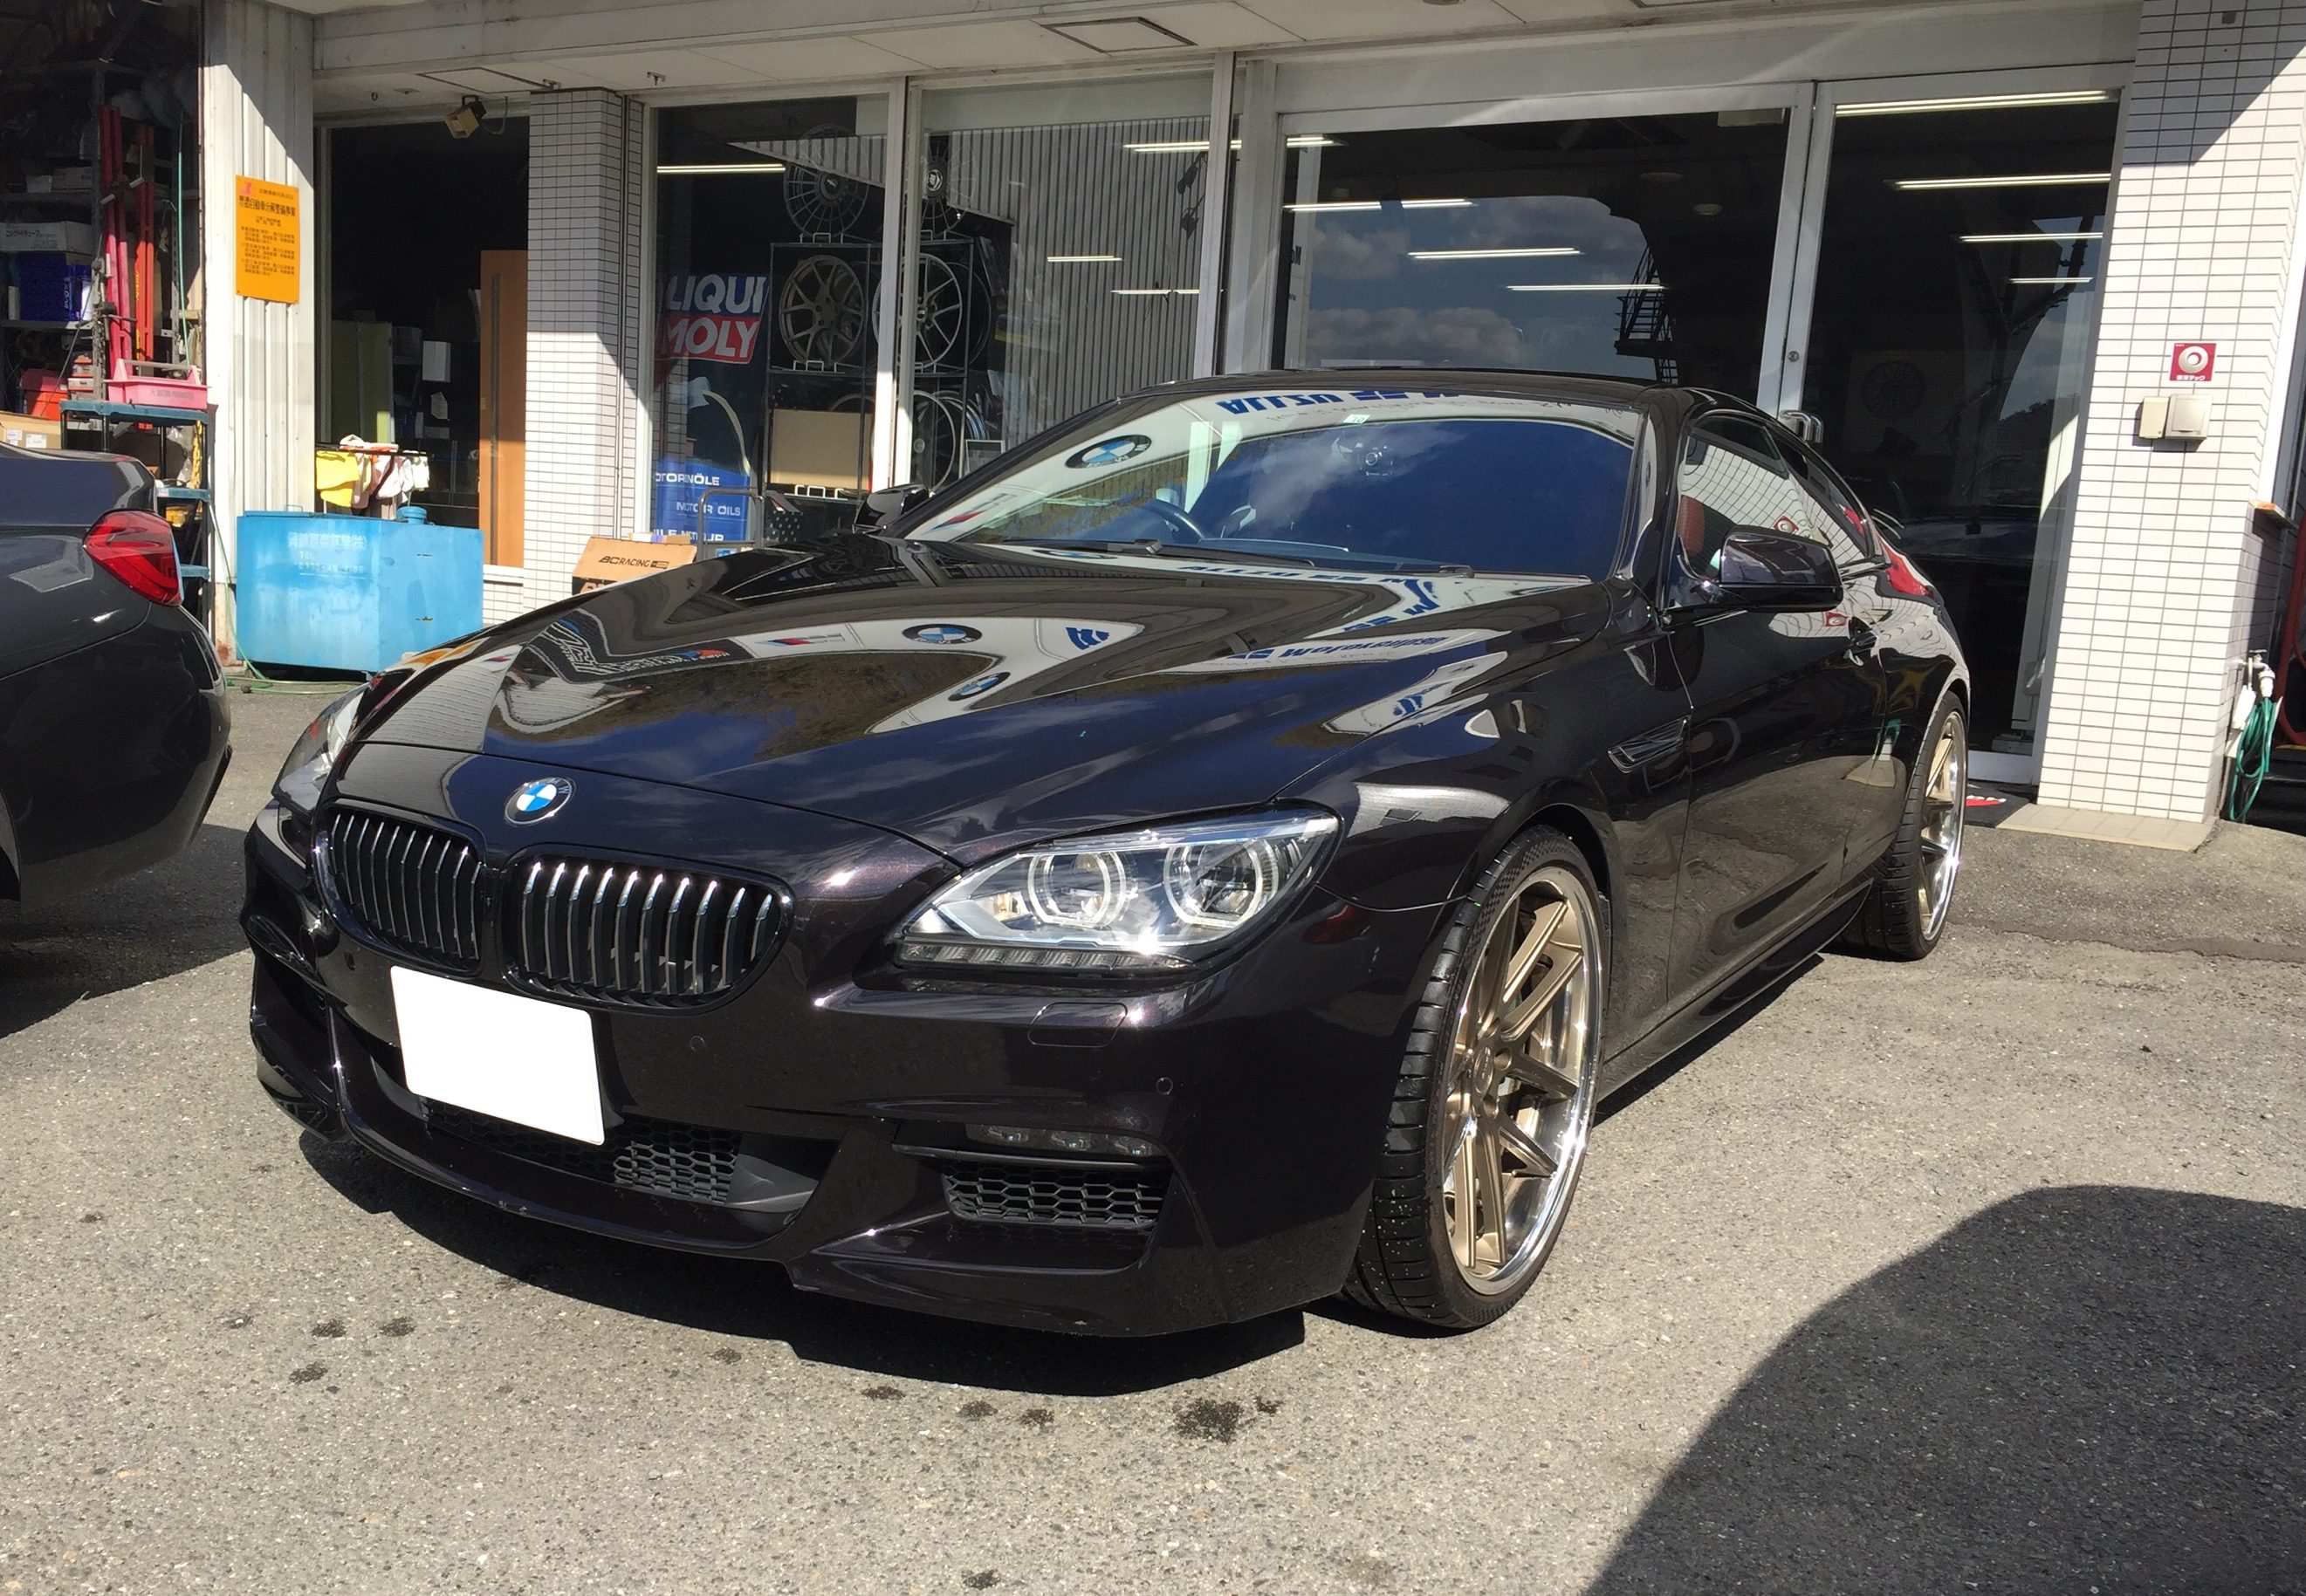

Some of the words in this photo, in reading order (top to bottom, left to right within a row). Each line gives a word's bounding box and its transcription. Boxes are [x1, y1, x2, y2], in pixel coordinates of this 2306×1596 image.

[665, 274, 766, 313] LIQUI
[662, 317, 761, 358] MOLY
[717, 505, 741, 517] OILS
